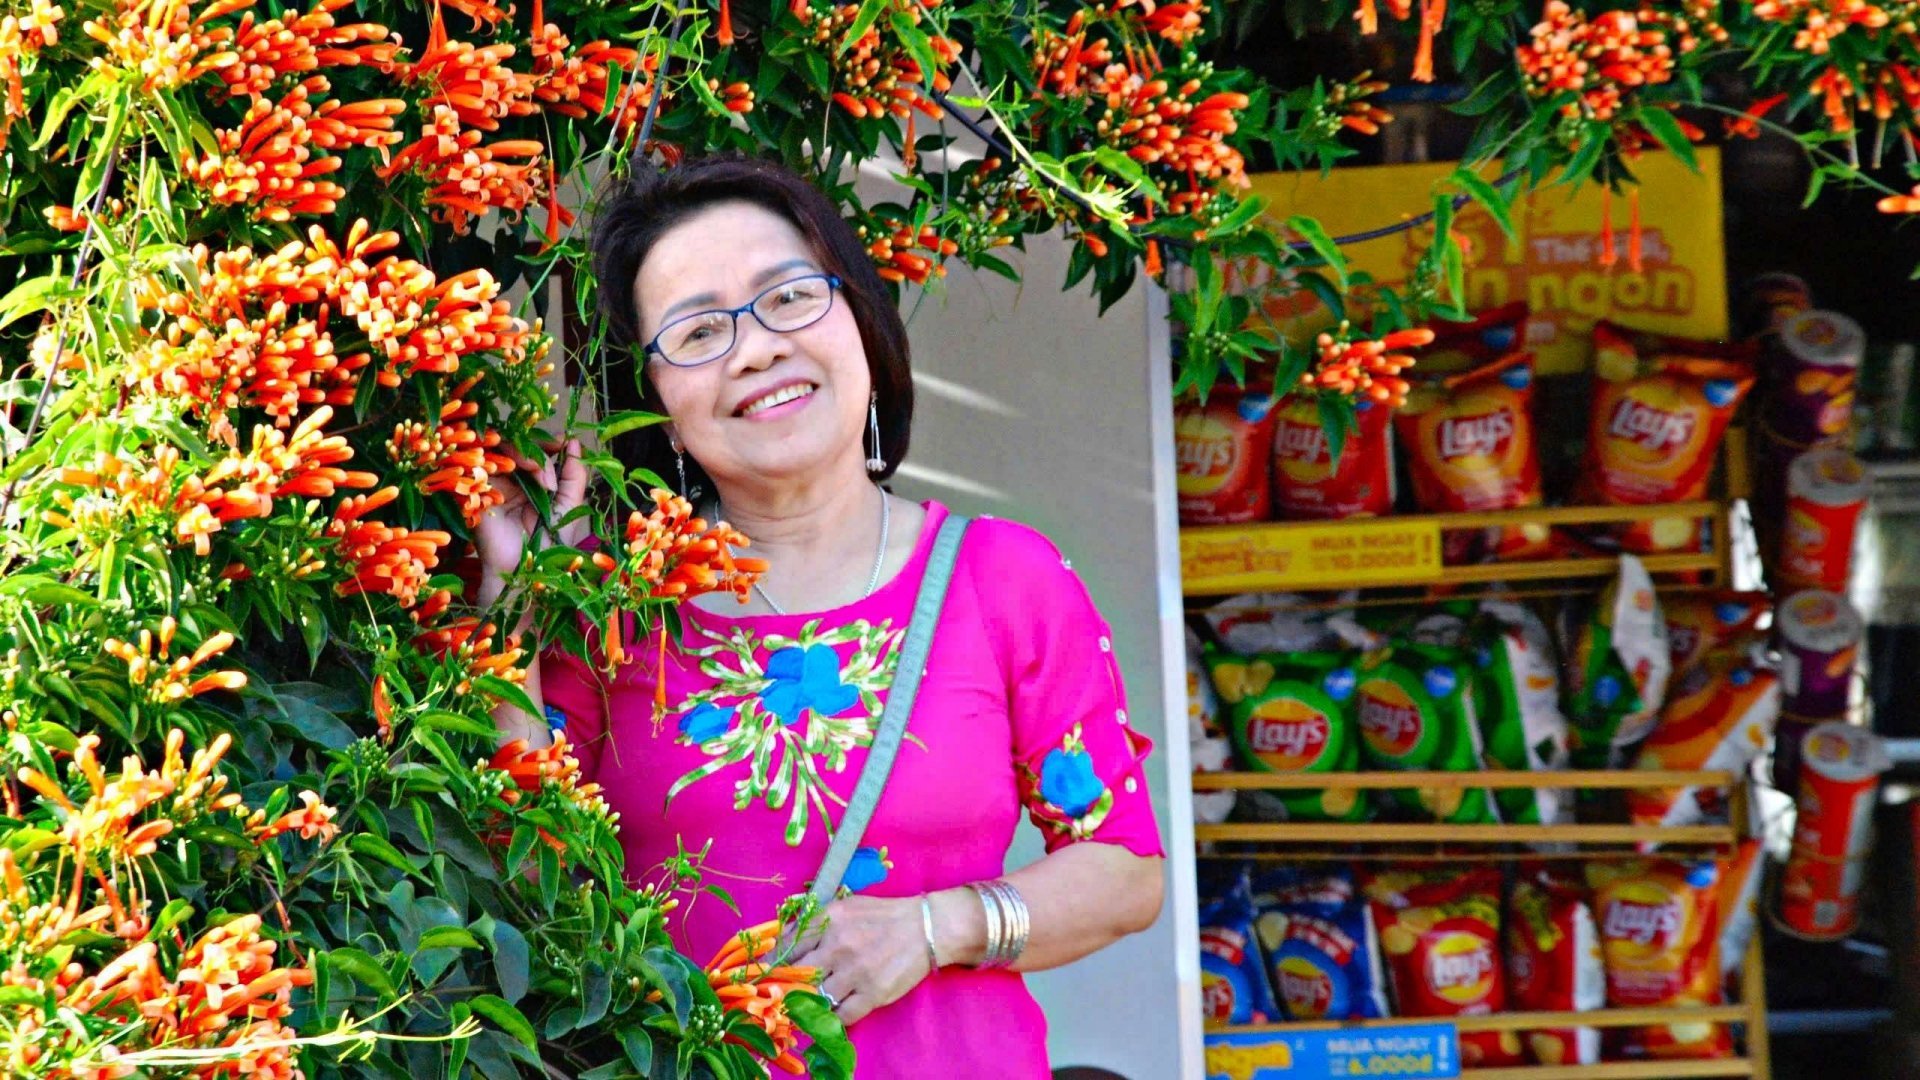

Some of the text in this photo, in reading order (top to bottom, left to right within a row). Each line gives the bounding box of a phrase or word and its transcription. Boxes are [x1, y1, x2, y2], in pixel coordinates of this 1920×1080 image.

[1441, 411, 1512, 456] Lay's
[1610, 399, 1695, 448] Lay's
[1254, 715, 1325, 756] Lay's
[1603, 899, 1681, 944] Lay's
[1432, 948, 1493, 988] Lay's
